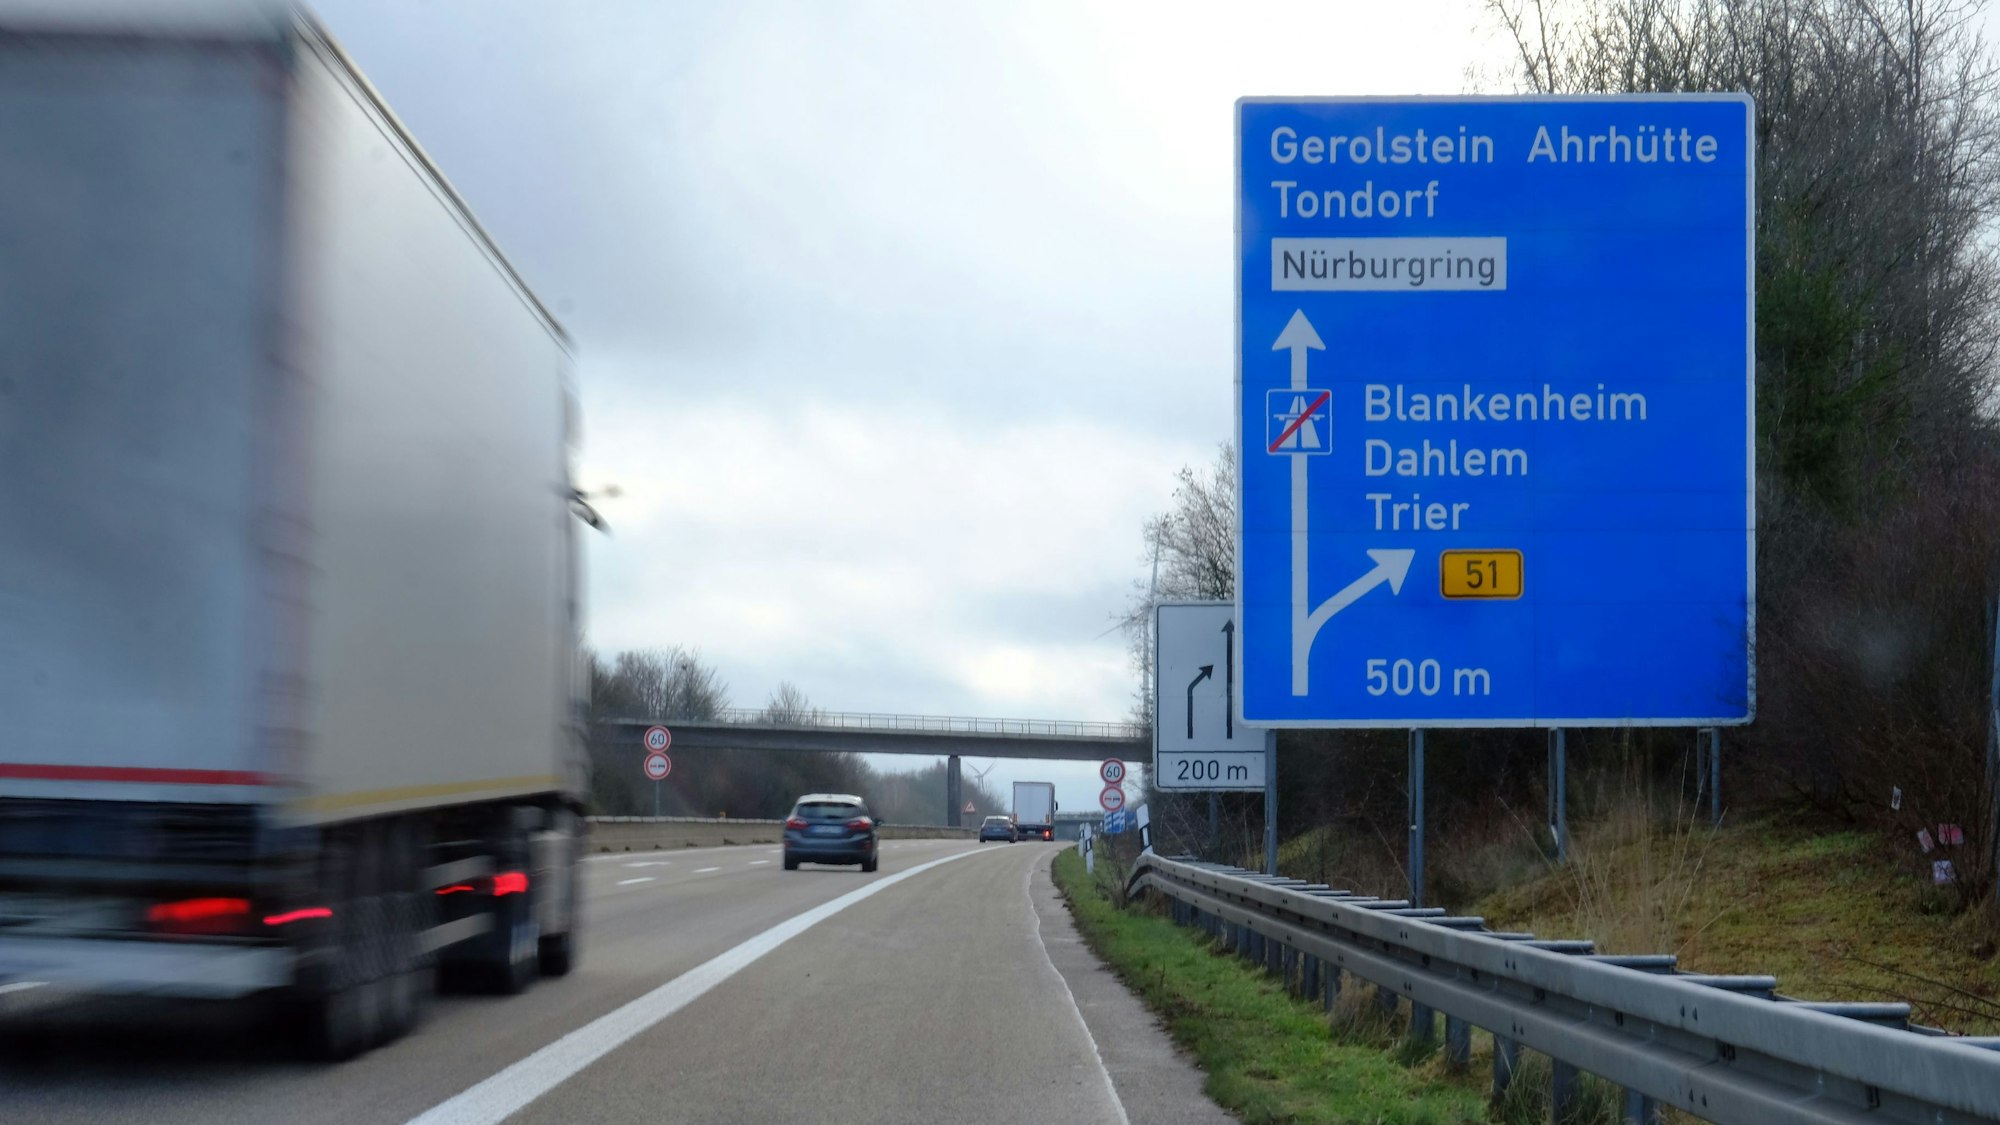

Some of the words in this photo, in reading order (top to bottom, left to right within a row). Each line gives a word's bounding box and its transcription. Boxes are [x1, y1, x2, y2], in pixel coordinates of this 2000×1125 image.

[1270, 126, 1494, 164] Gerolstein
[1527, 125, 1718, 163] Ahrhütte
[1270, 180, 1439, 218] Tondorf
[1283, 250, 1496, 287] Nürburgring
[1365, 383, 1647, 422] Blankenheim
[1365, 439, 1528, 477] Dahlem
[1365, 493, 1470, 531] Trier
[1465, 560, 1499, 589] 51
[1366, 658, 1441, 696] 500
[1453, 668, 1491, 696] m
[650, 732, 665, 746] 60
[1105, 765, 1120, 778] 60
[1177, 759, 1220, 781] 200
[1226, 764, 1248, 780] m
